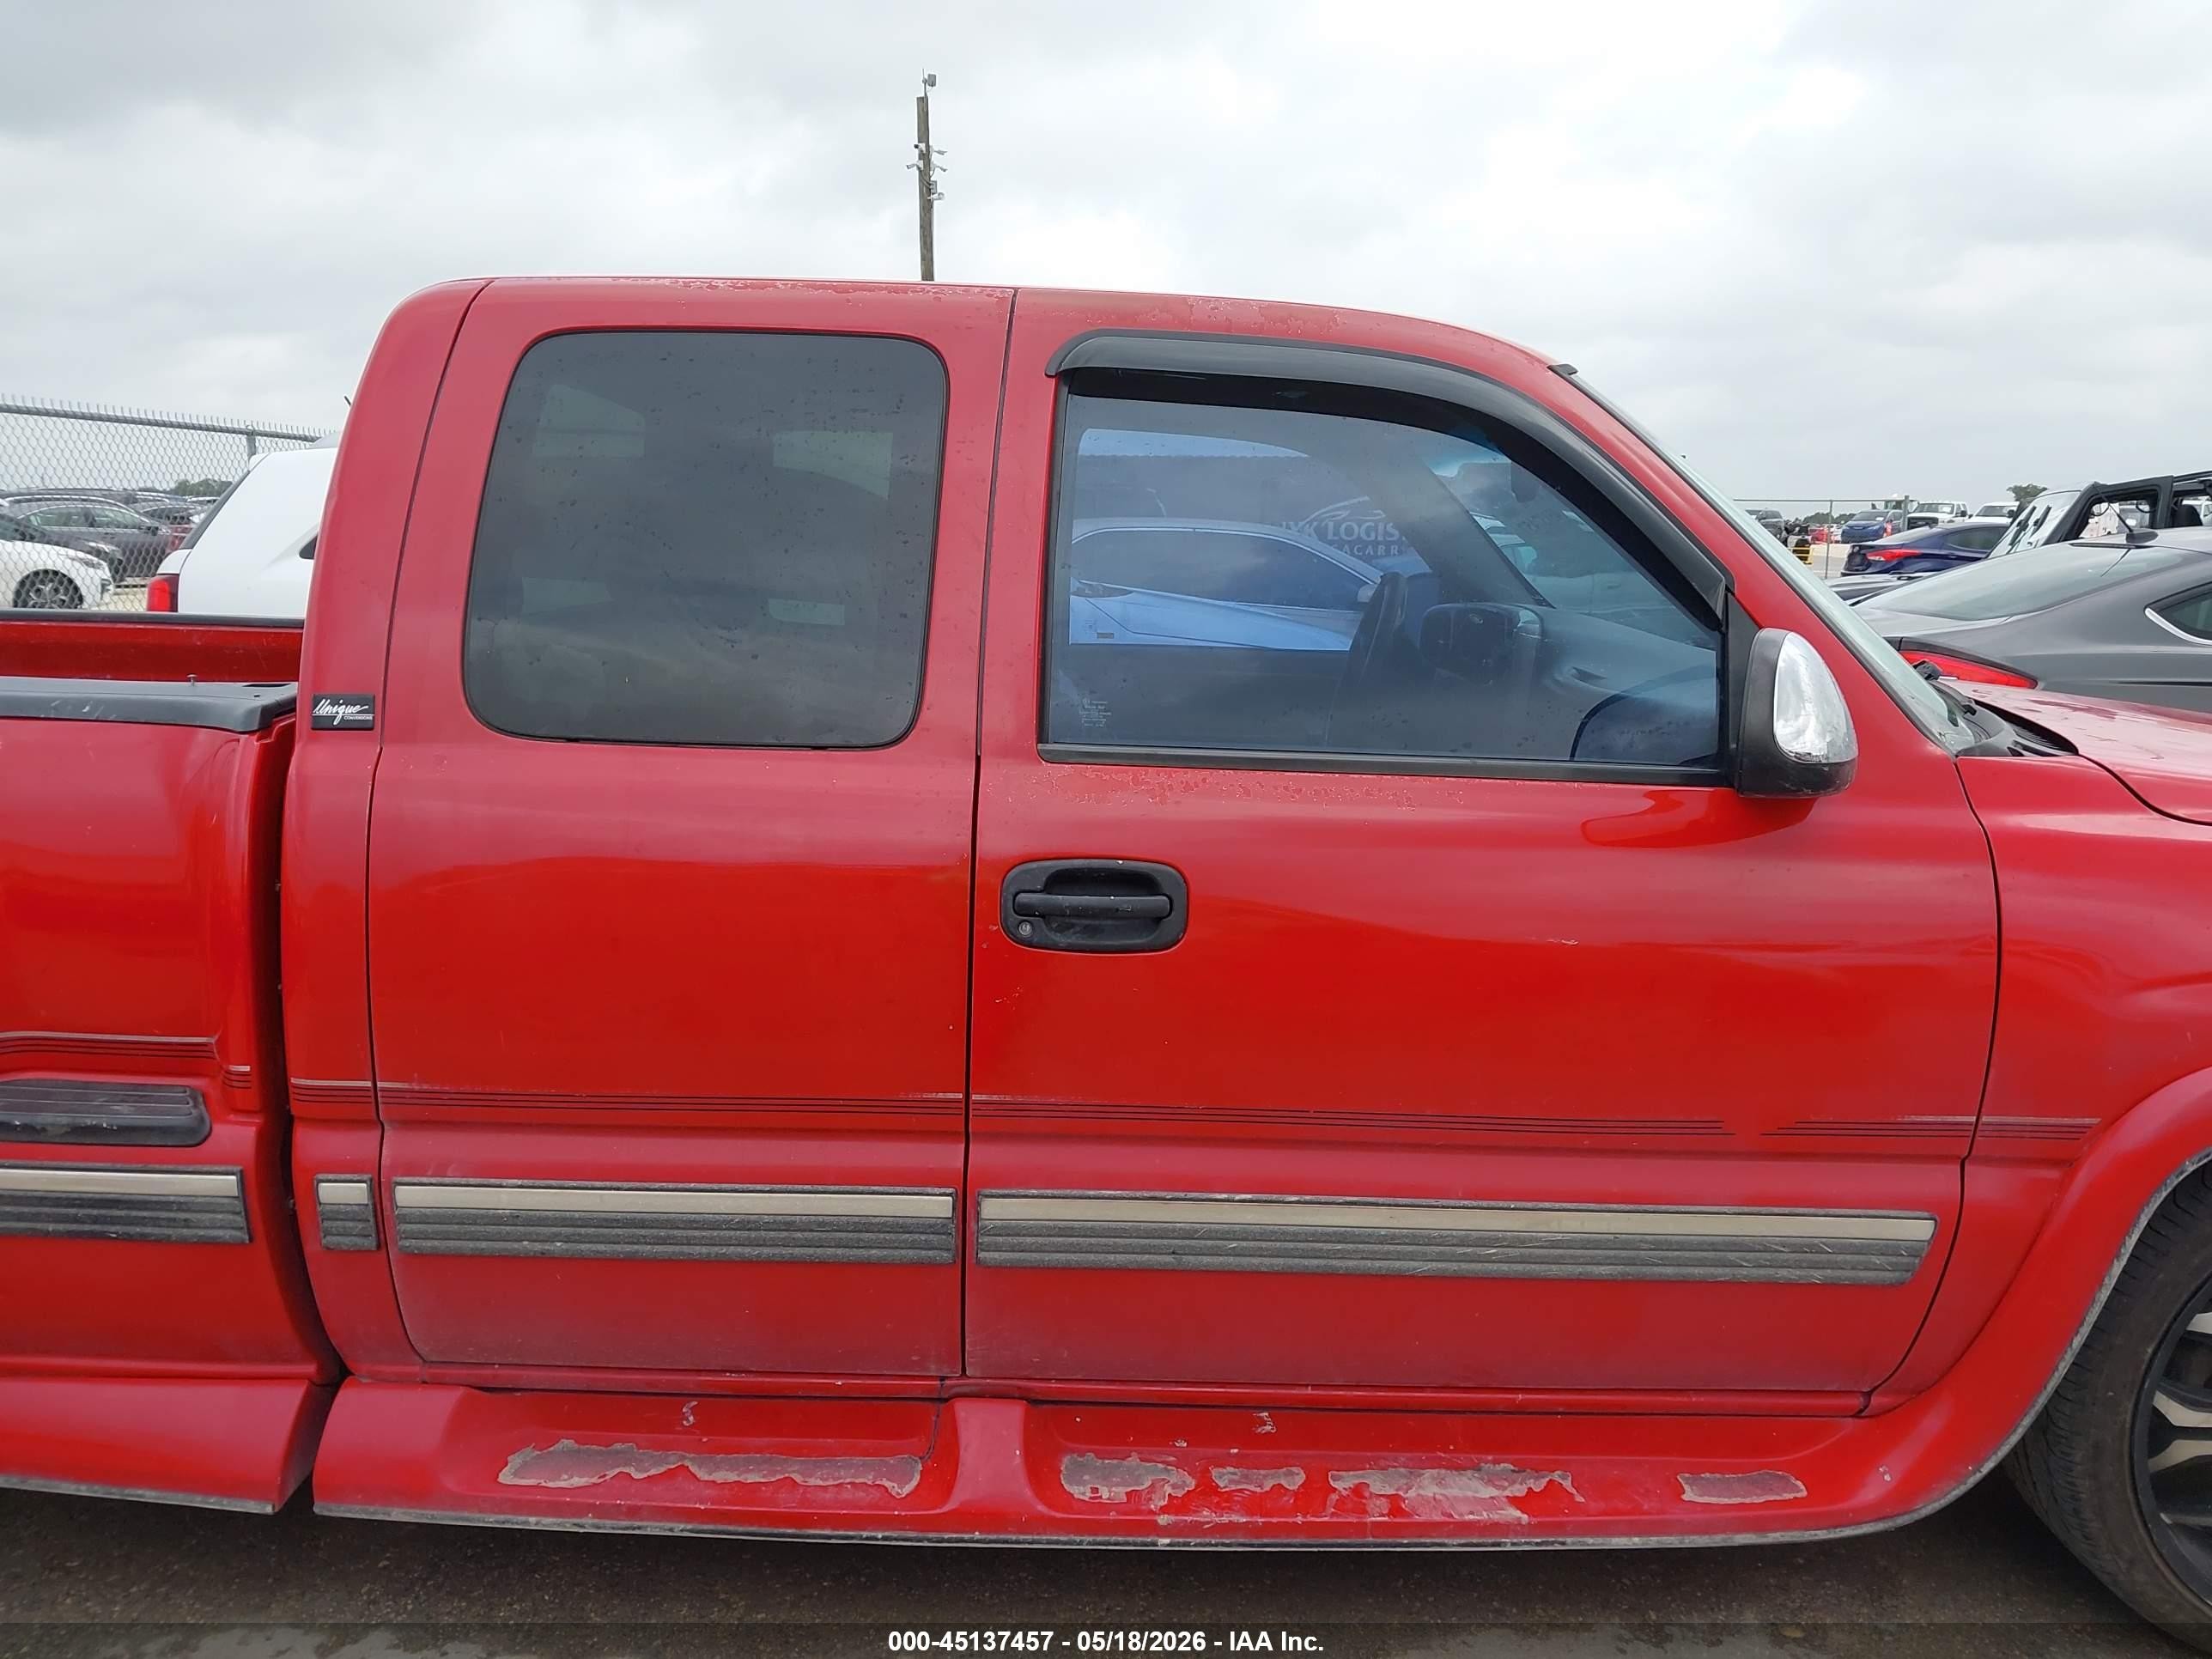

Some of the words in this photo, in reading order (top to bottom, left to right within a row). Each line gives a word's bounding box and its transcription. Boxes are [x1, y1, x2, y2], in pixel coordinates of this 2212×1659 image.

[1326, 521, 1406, 541] LOGIS
[1332, 544, 1407, 556] ACARR
[313, 698, 368, 725] Unique
